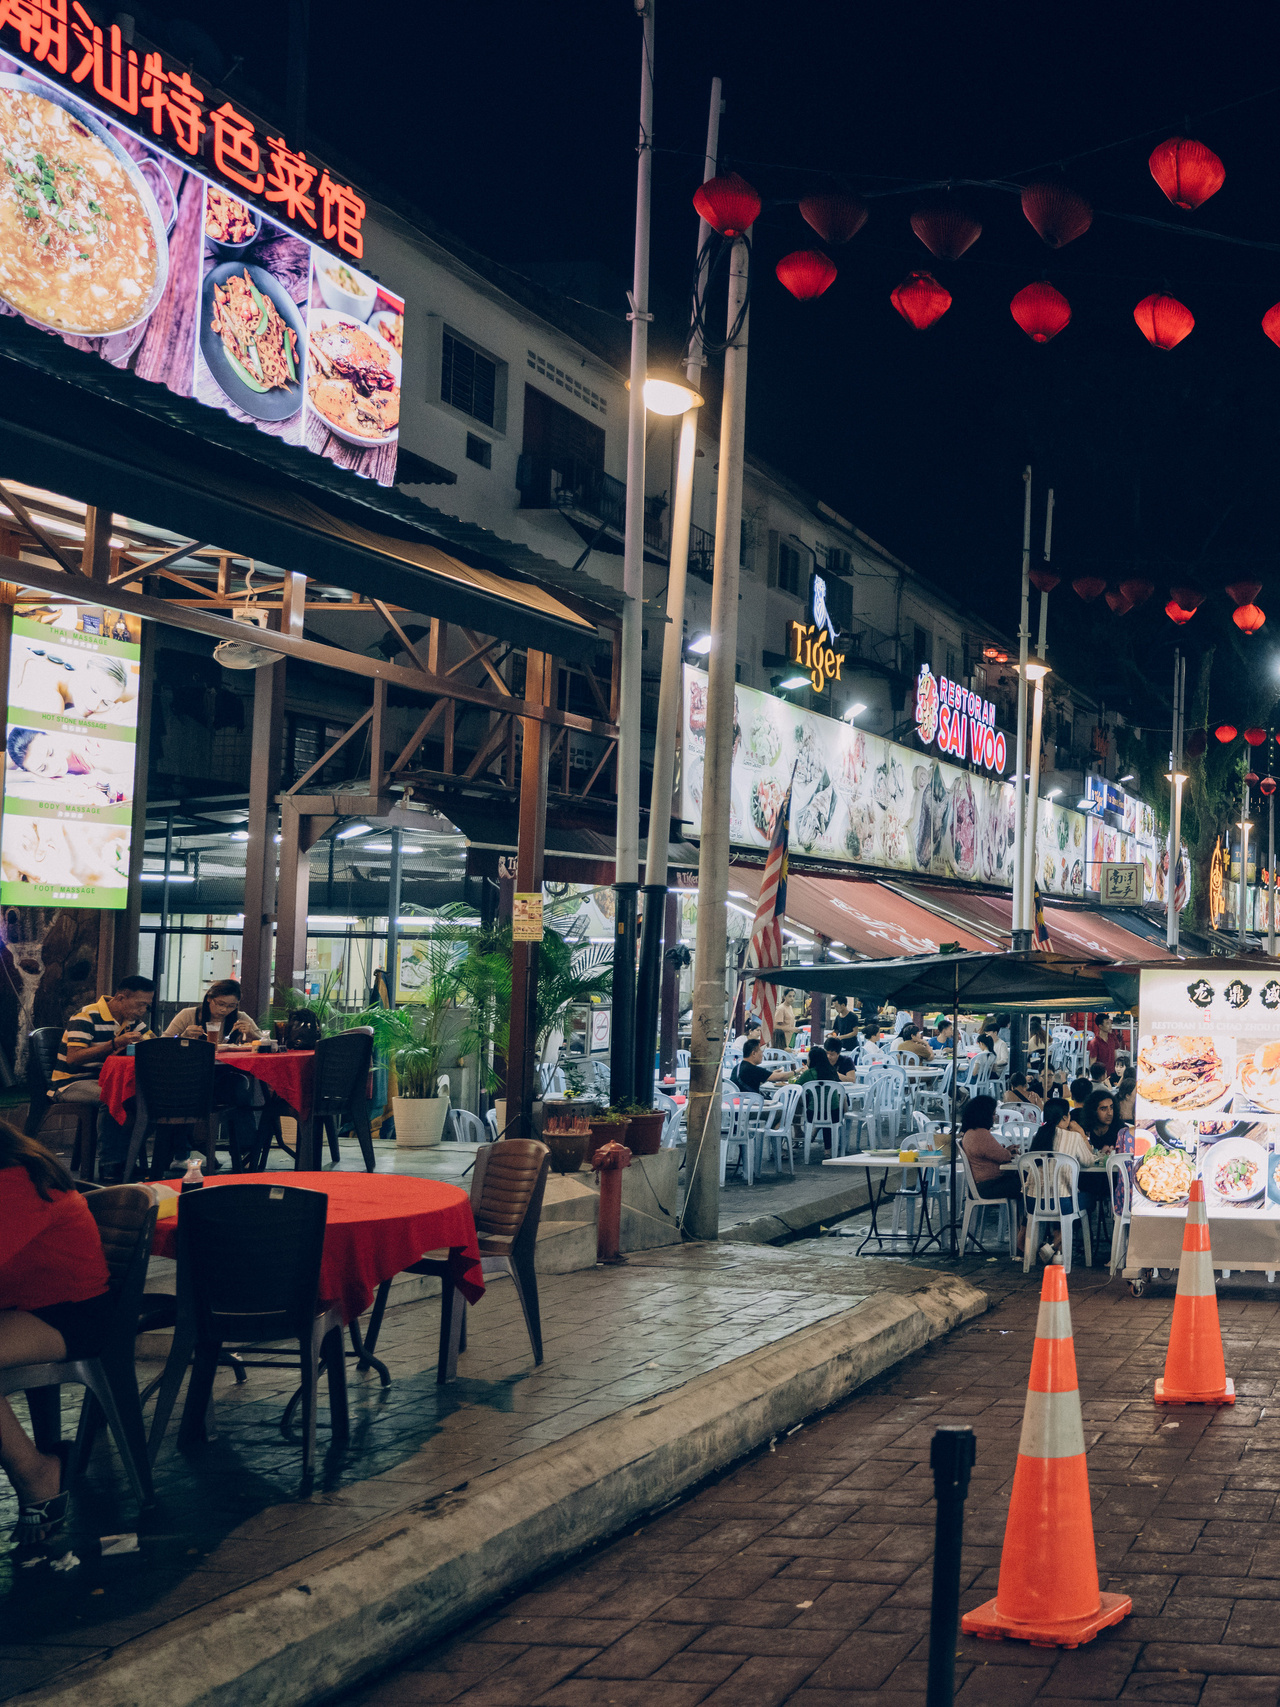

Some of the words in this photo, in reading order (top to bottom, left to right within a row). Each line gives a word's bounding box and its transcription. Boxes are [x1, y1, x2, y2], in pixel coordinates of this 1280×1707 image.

[50, 627, 68, 637] THAI
[73, 633, 108, 646] MASSAGE
[792, 620, 845, 692] Tiger
[939, 675, 996, 727] RESTORAN
[56, 715, 77, 725] STONE
[78, 720, 107, 730] MASSAGE
[937, 704, 967, 760] SAI
[969, 718, 1007, 775] WOO
[38, 802, 60, 810] BODY
[65, 805, 101, 814] MASSAGE
[1152, 1021, 1196, 1030] RESTORAN
[1216, 1022, 1242, 1031] CHAO
[1244, 1023, 1270, 1032] ZHOU
